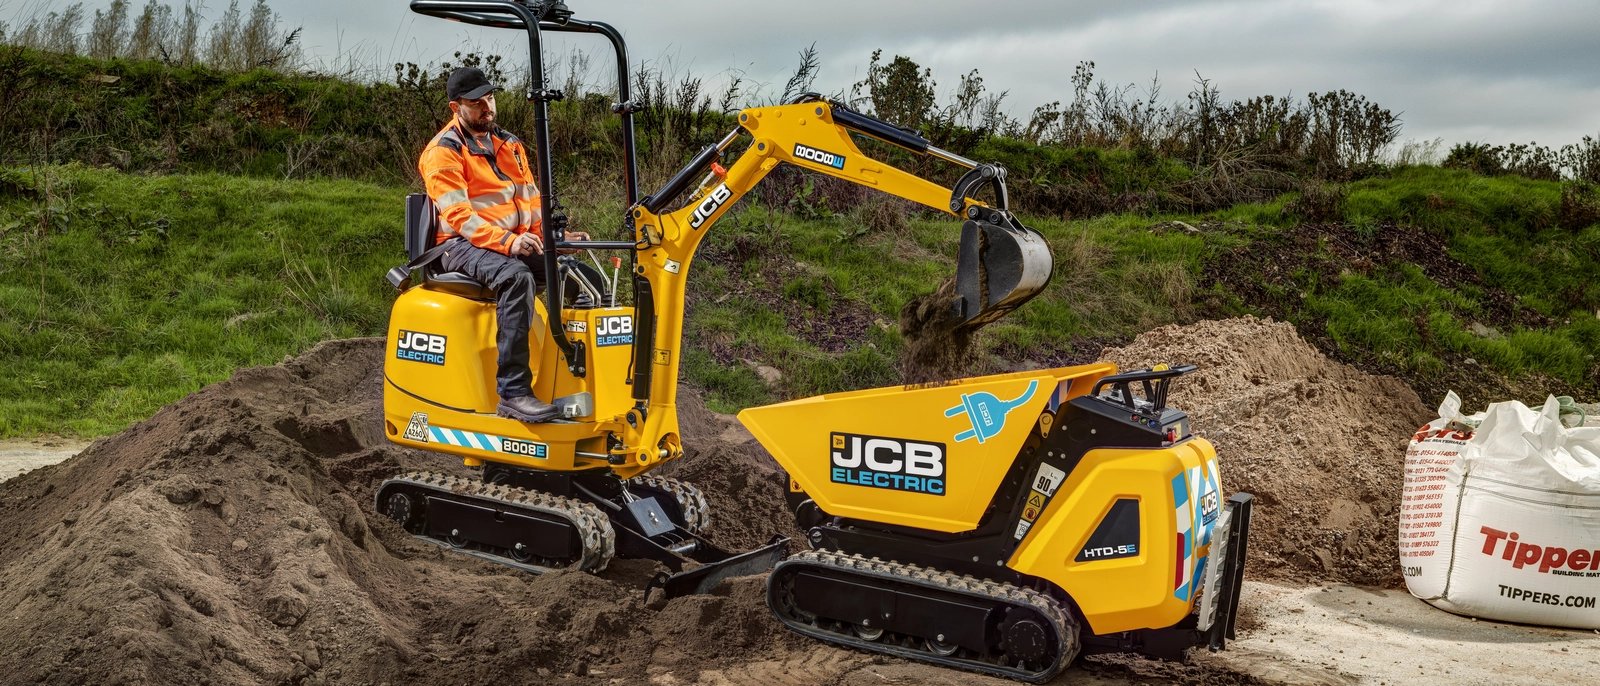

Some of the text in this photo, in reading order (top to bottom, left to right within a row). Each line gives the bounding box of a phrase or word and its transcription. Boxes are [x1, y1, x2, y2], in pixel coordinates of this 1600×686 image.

[796, 145, 844, 169] 8008E
[691, 184, 731, 228] JCB
[597, 316, 632, 335] JCB
[398, 332, 446, 354] JCB
[597, 335, 633, 345] ELECTRIC
[397, 349, 444, 364] ELECTRIC
[503, 440, 545, 457] 8008E
[833, 437, 943, 477] JCB
[833, 467, 943, 493] ELECTRIC
[1037, 475, 1051, 492] 90
[1202, 491, 1217, 516] JCB
[1084, 544, 1136, 558] HTD-5E
[1498, 584, 1596, 608] TIPPERS.COM
